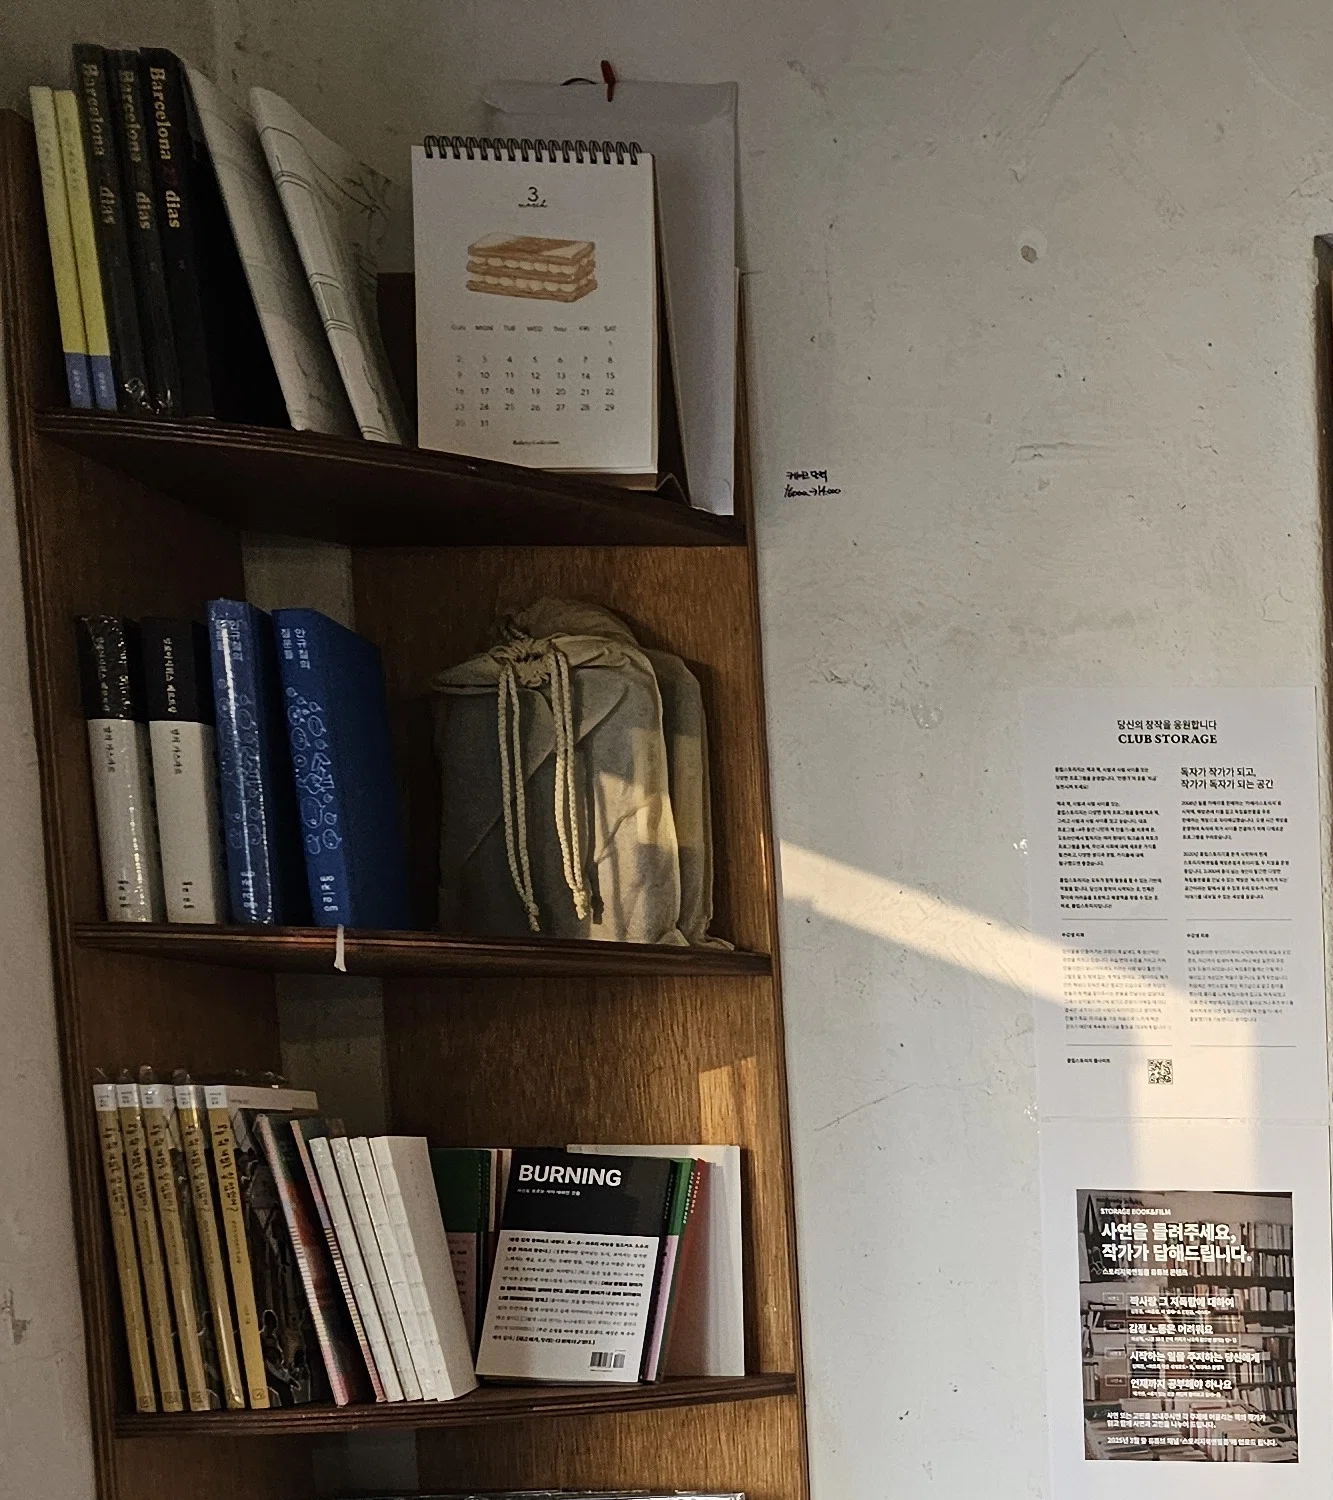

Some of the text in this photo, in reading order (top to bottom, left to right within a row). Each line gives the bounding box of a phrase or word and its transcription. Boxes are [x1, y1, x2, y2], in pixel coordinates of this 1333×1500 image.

[119, 70, 150, 230] Barcelona dias
[149, 67, 180, 229] Barcelona dias
[528, 187, 539, 201] 3
[1117, 720, 1217, 731] 당신의 창작을 응원합니다
[1118, 734, 1217, 744] CLUB STORAGE
[518, 1165, 622, 1187] BURNING
[1101, 1222, 1236, 1243] 사연을 들려주세요,
[1101, 1243, 1252, 1263] 작가가 답해드립니다.
